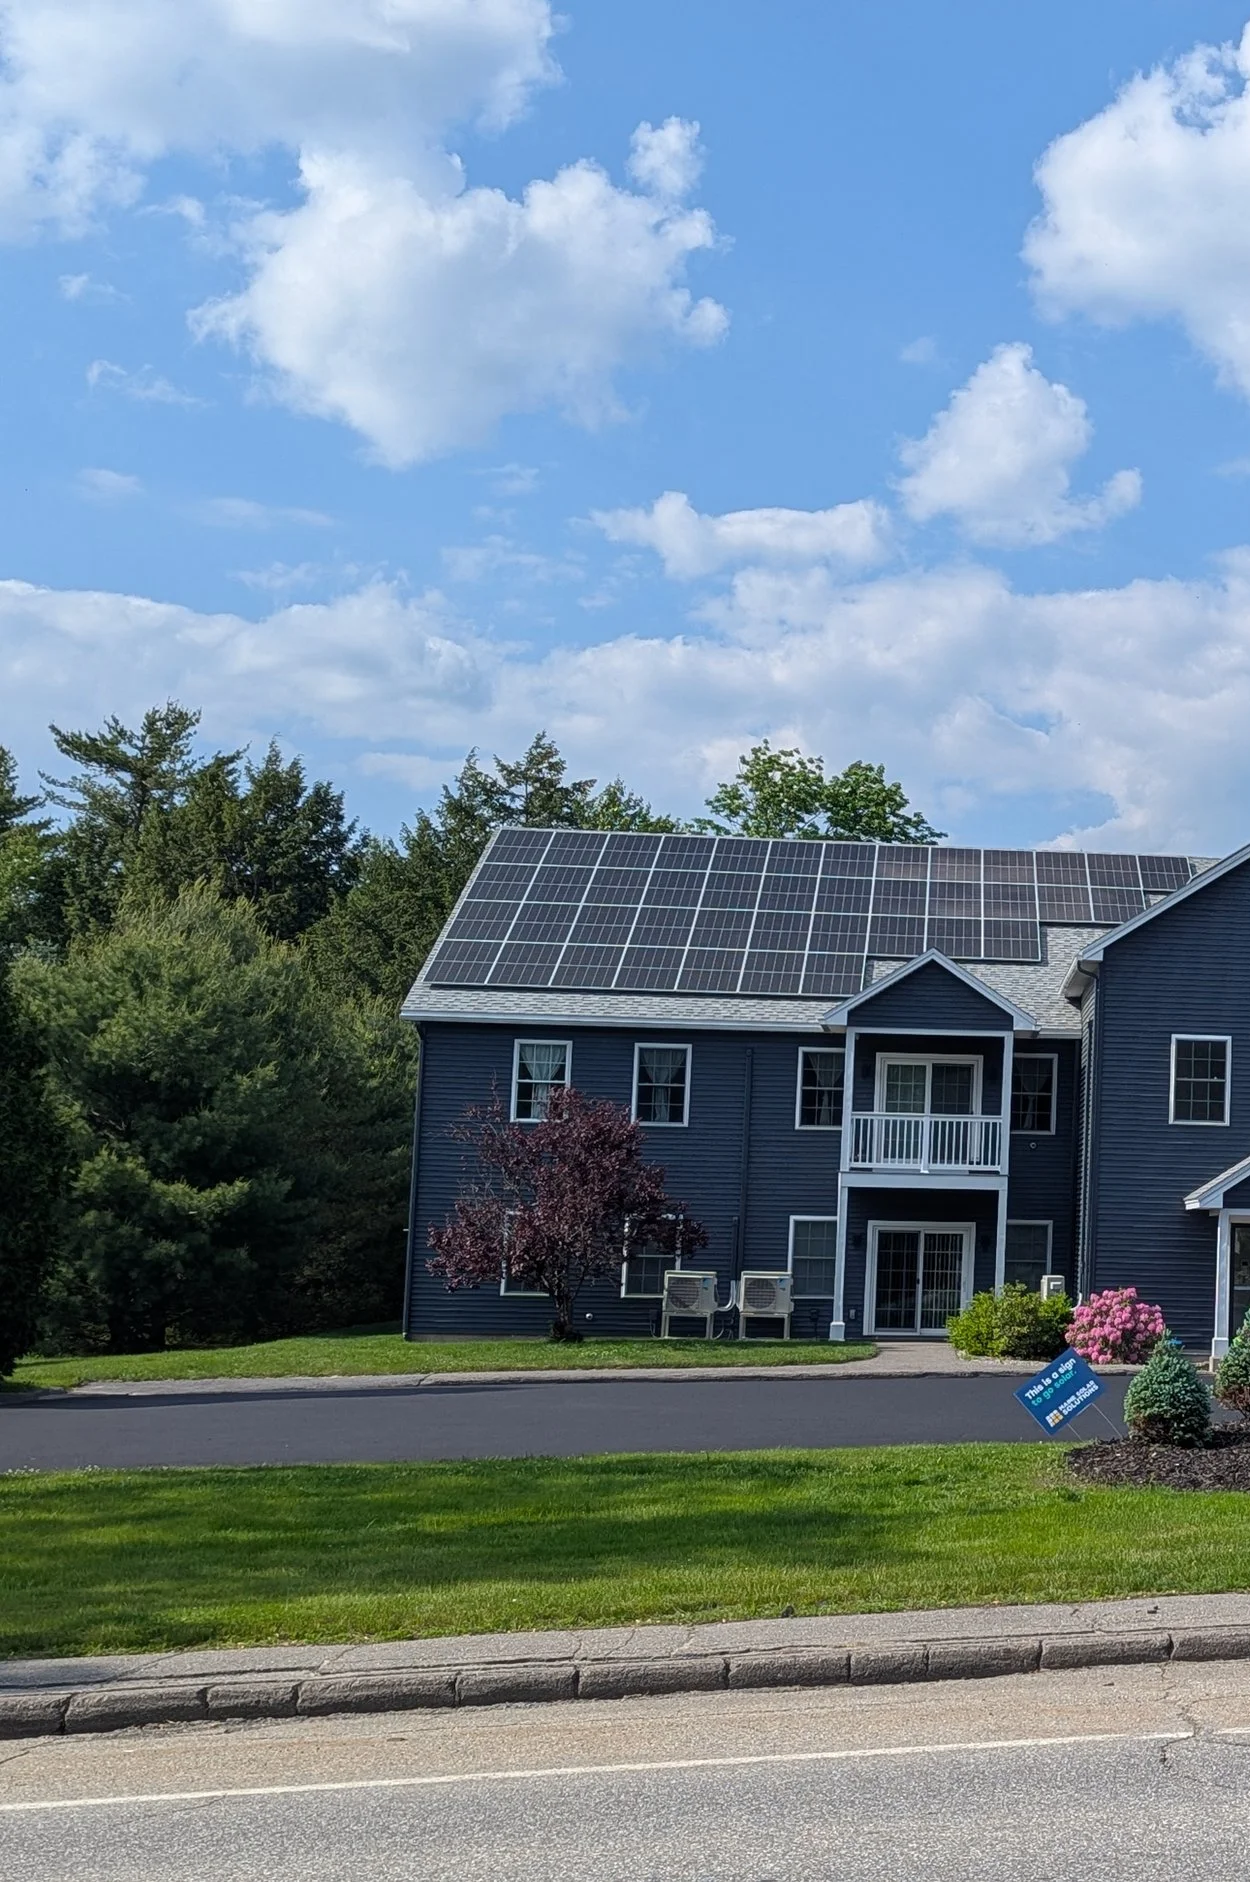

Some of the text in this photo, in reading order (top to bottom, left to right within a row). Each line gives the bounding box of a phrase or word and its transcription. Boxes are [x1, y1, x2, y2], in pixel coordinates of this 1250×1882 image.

[1025, 1358, 1076, 1400] This is a sign
[1031, 1370, 1077, 1406] to go solar.
[1075, 1380, 1095, 1397] SOLAR
[1062, 1385, 1099, 1416] SOLUTIONS
